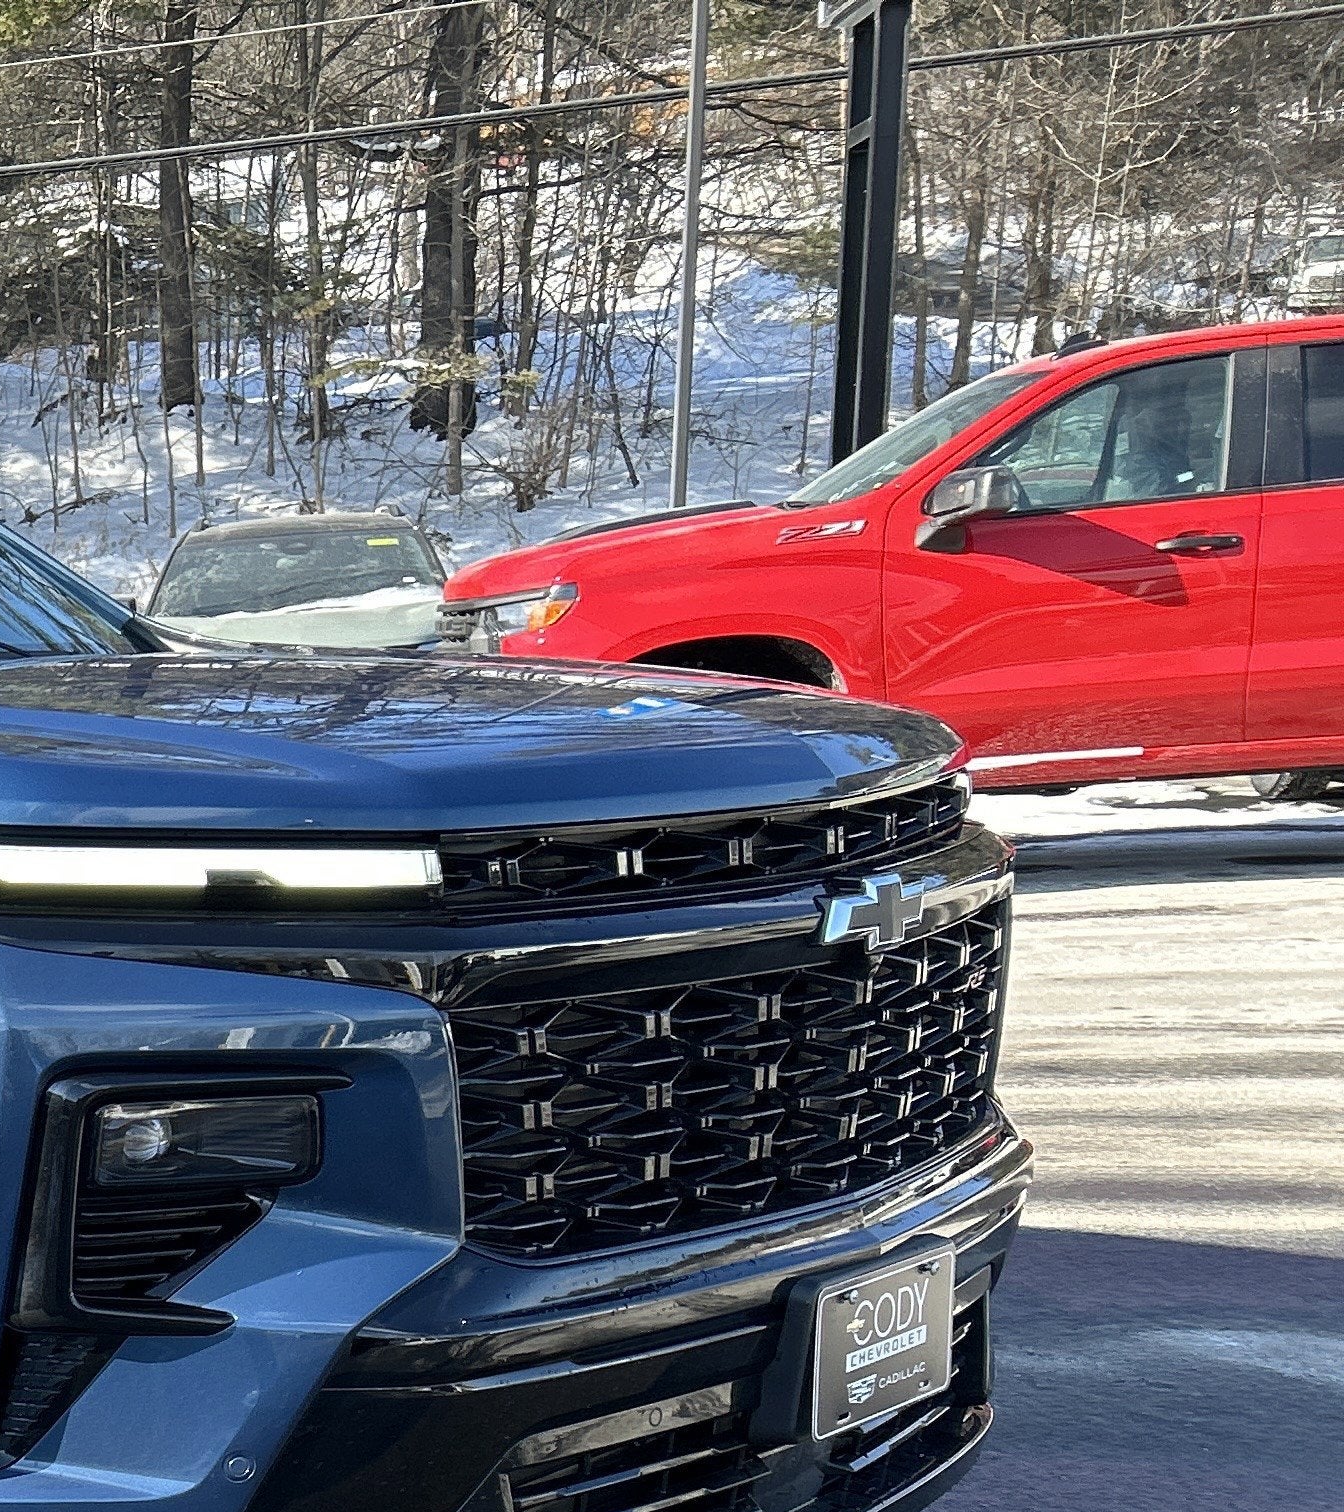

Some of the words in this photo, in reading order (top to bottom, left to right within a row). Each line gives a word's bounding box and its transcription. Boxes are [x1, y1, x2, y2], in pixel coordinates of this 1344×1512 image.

[852, 1277, 930, 1346] CODY
[849, 1328, 924, 1369] CHEVROLET
[878, 1361, 926, 1389] CADILLAC
